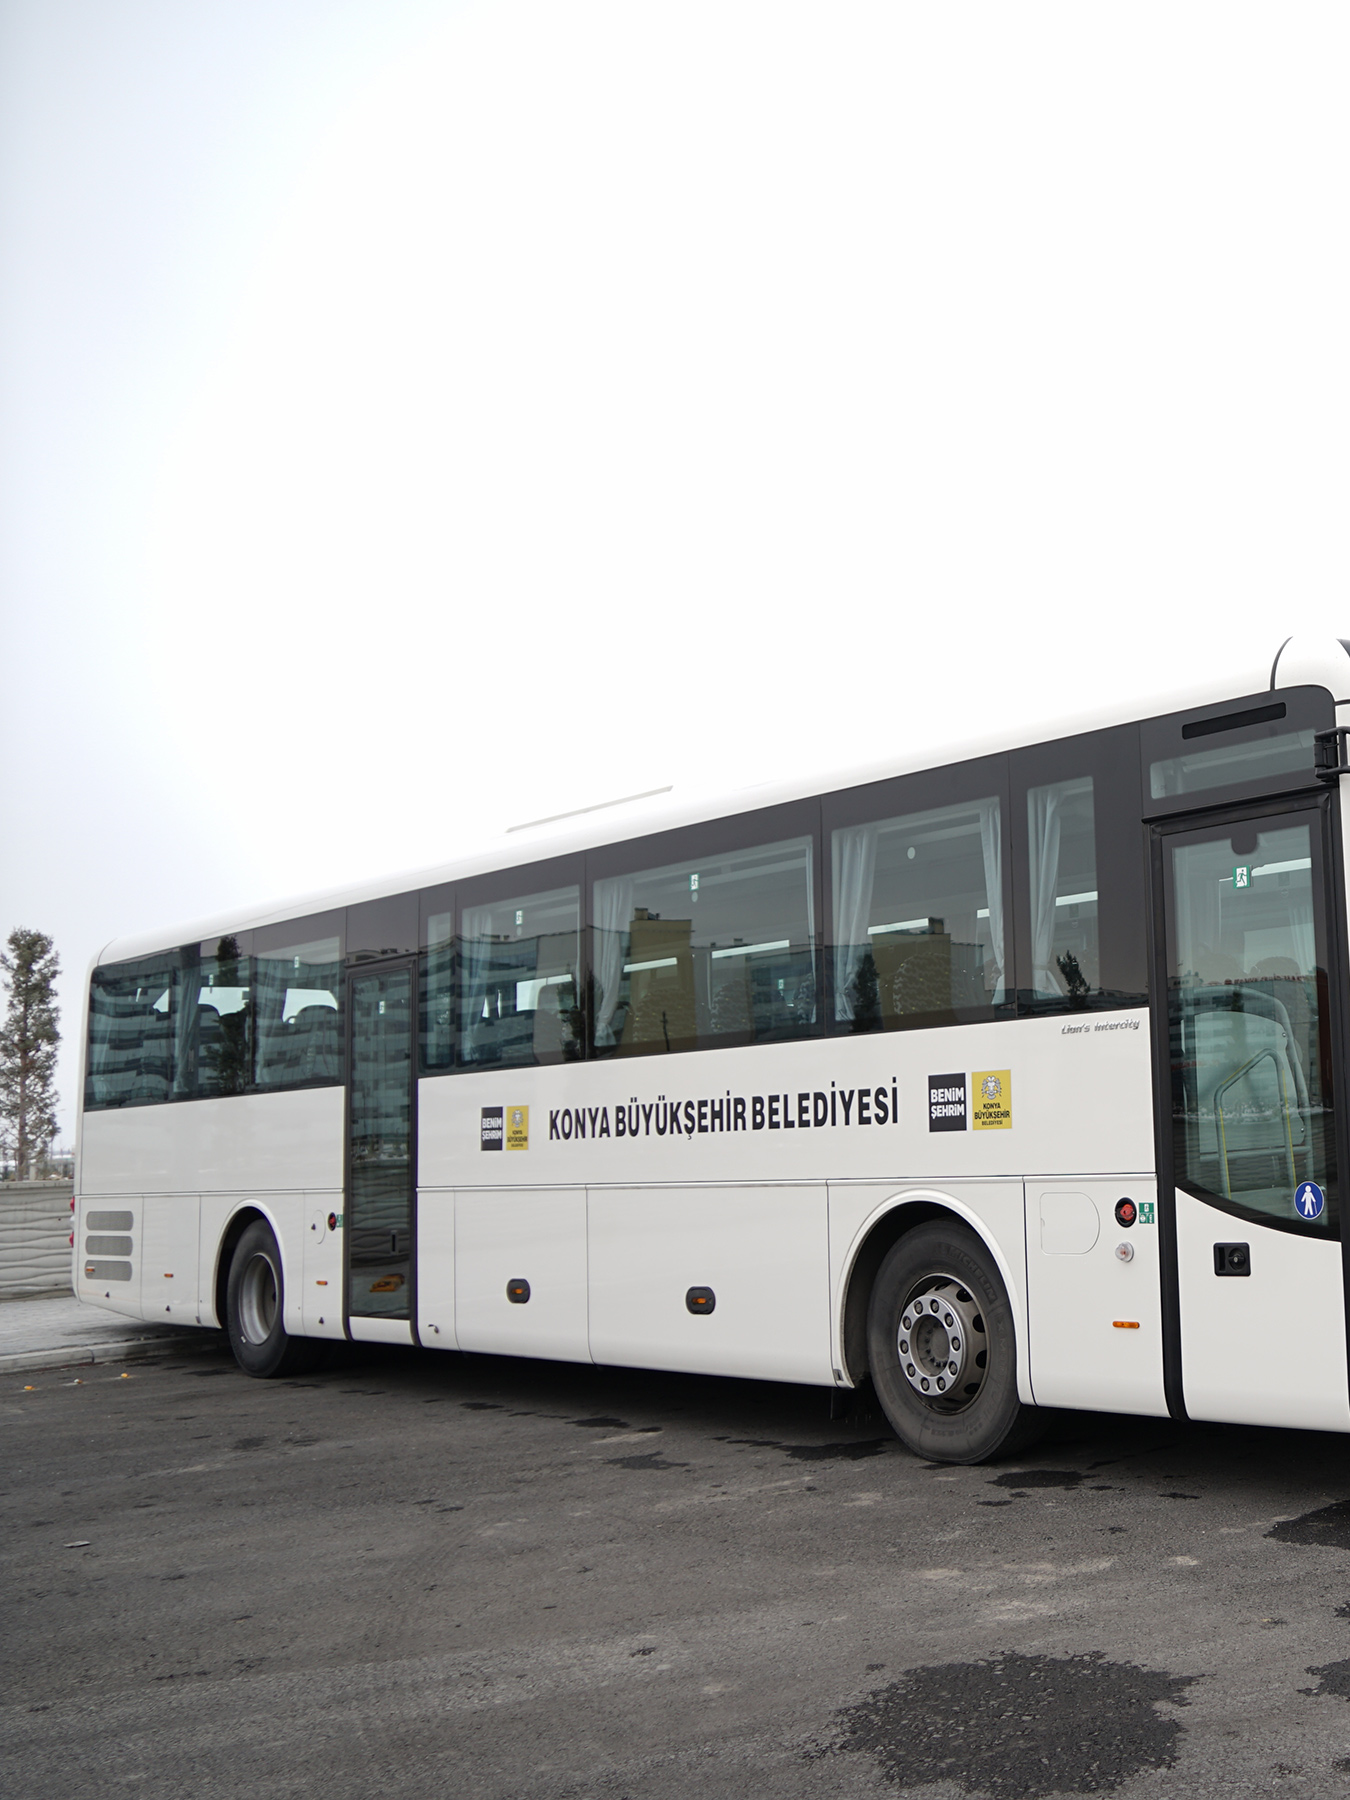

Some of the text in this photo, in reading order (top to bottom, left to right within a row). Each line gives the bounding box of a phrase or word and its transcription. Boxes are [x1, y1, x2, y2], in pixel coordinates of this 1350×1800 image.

[1061, 1023, 1090, 1035] Lion's
[549, 1077, 899, 1141] KONYA BÜYÜKŞEHİR BELEDİYESİ
[983, 1102, 1001, 1110] KONYA
